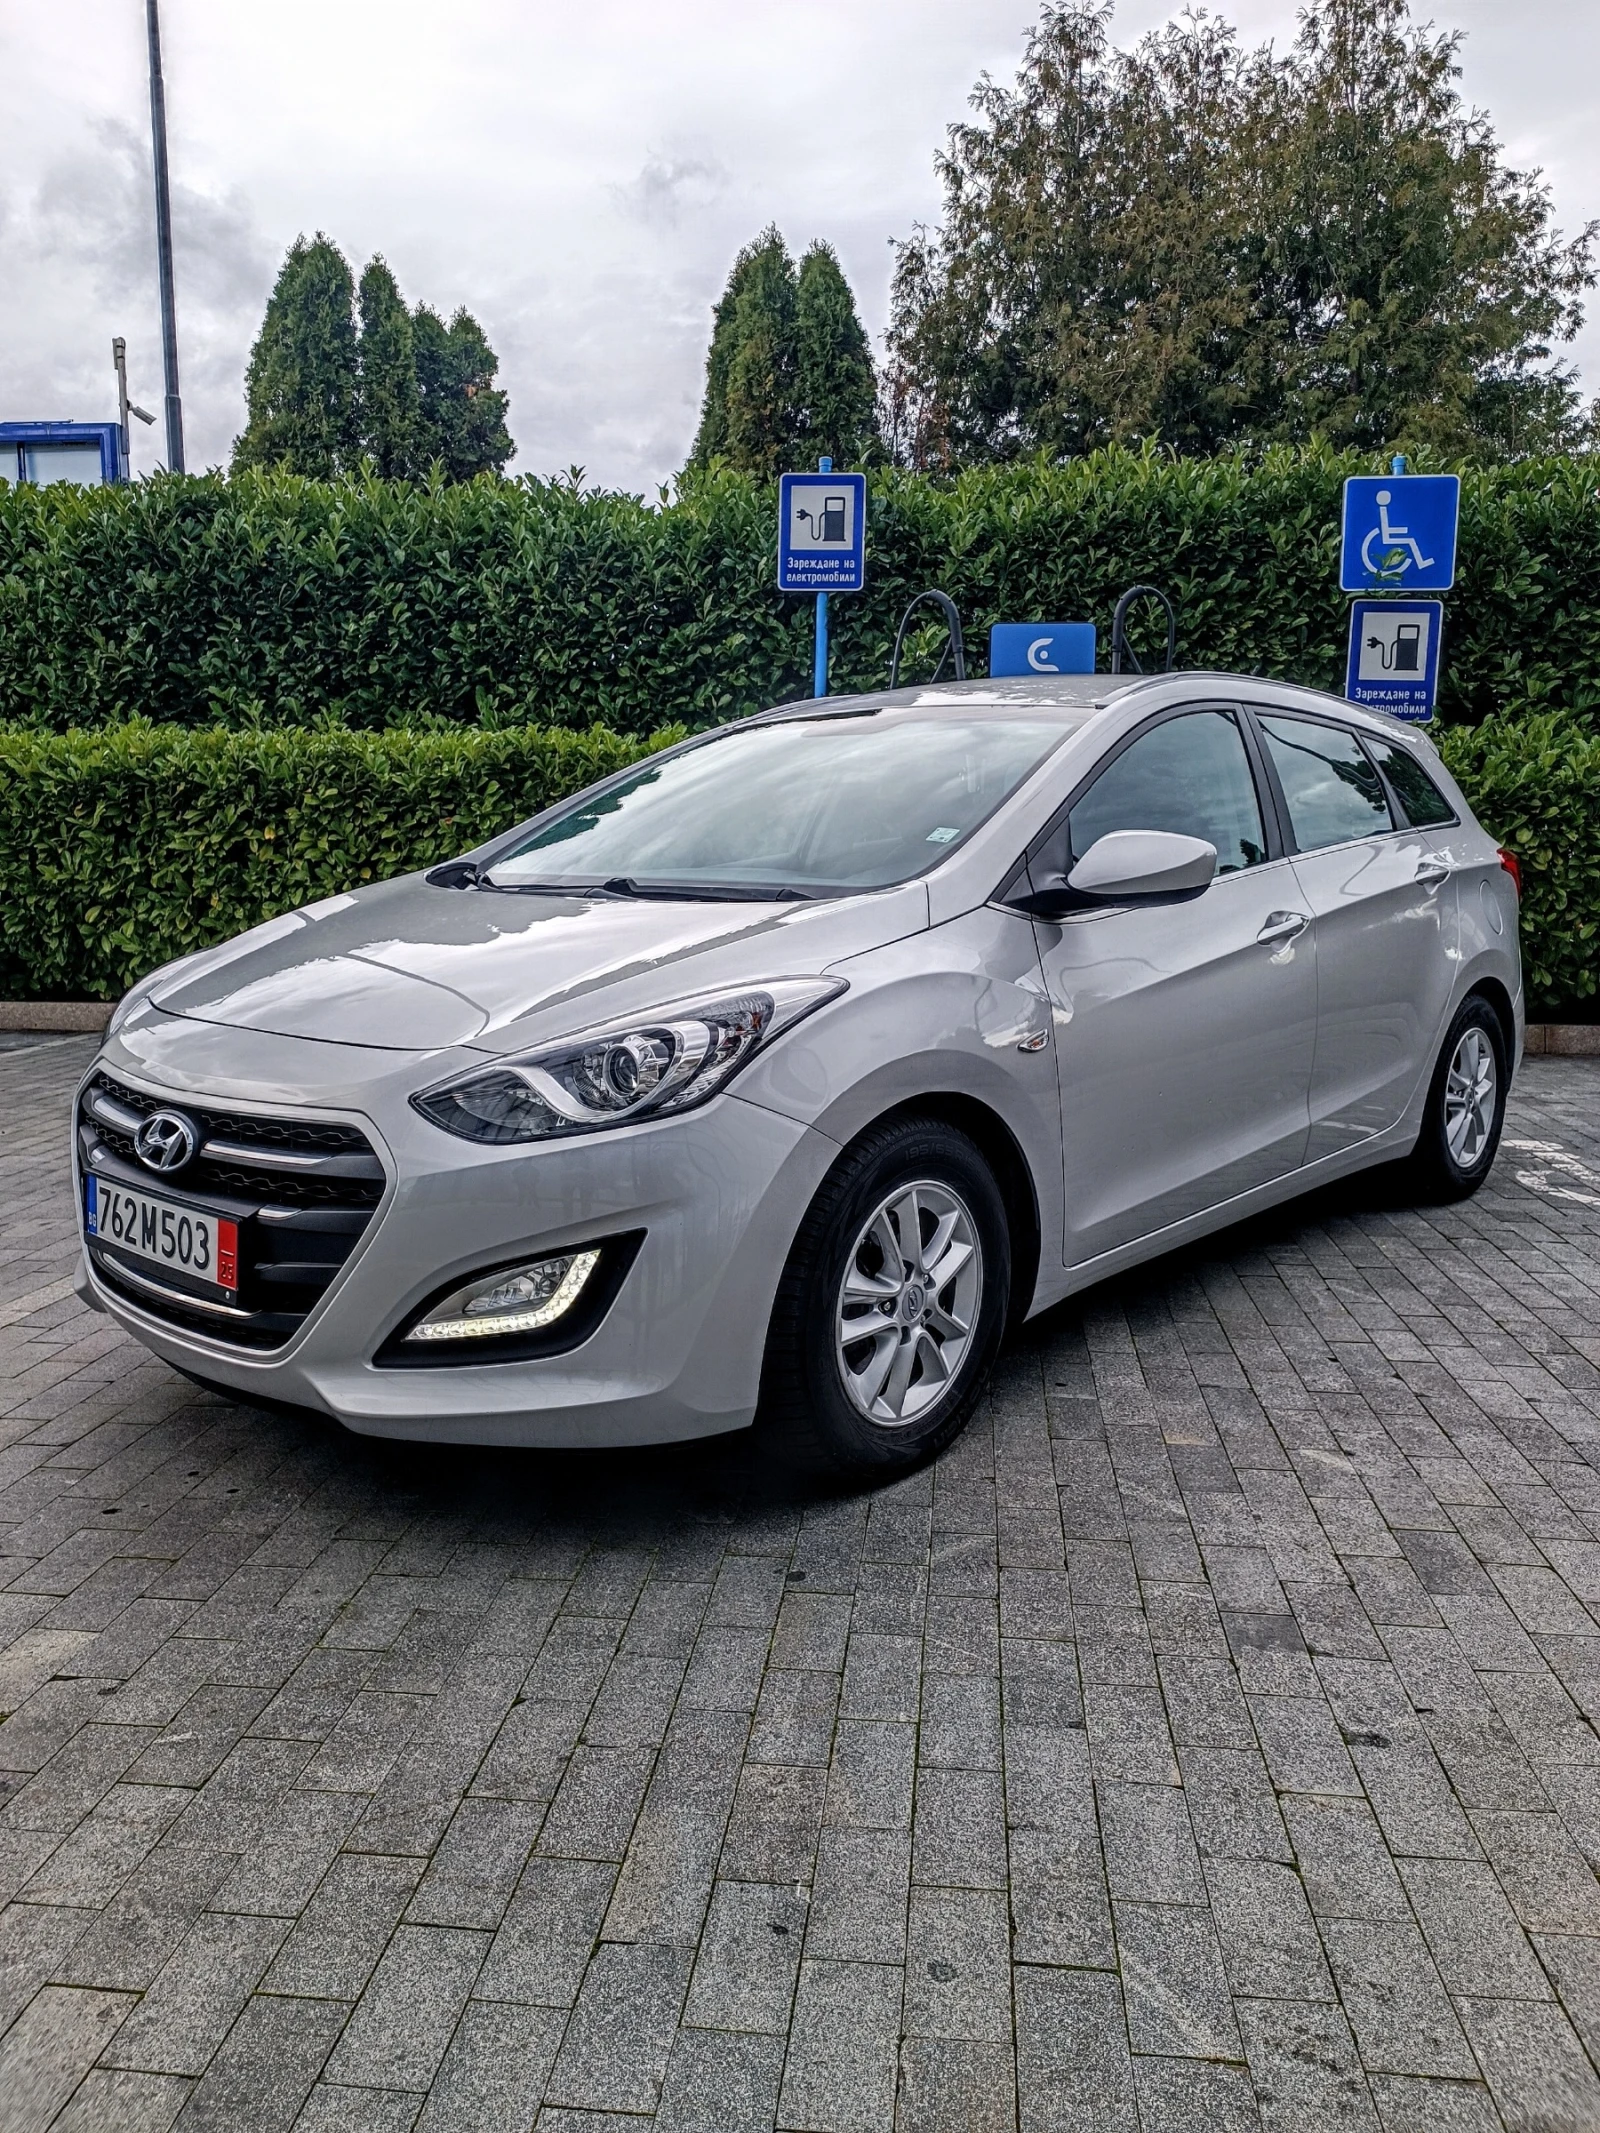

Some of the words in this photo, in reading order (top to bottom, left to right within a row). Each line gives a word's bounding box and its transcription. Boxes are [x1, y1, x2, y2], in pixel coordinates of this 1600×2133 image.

[787, 557, 840, 570] Зареждане
[843, 560, 855, 569] на
[786, 571, 855, 584] електромобили
[1355, 687, 1410, 701] Зареждане
[1414, 690, 1426, 700] на
[88, 1211, 97, 1228] BG
